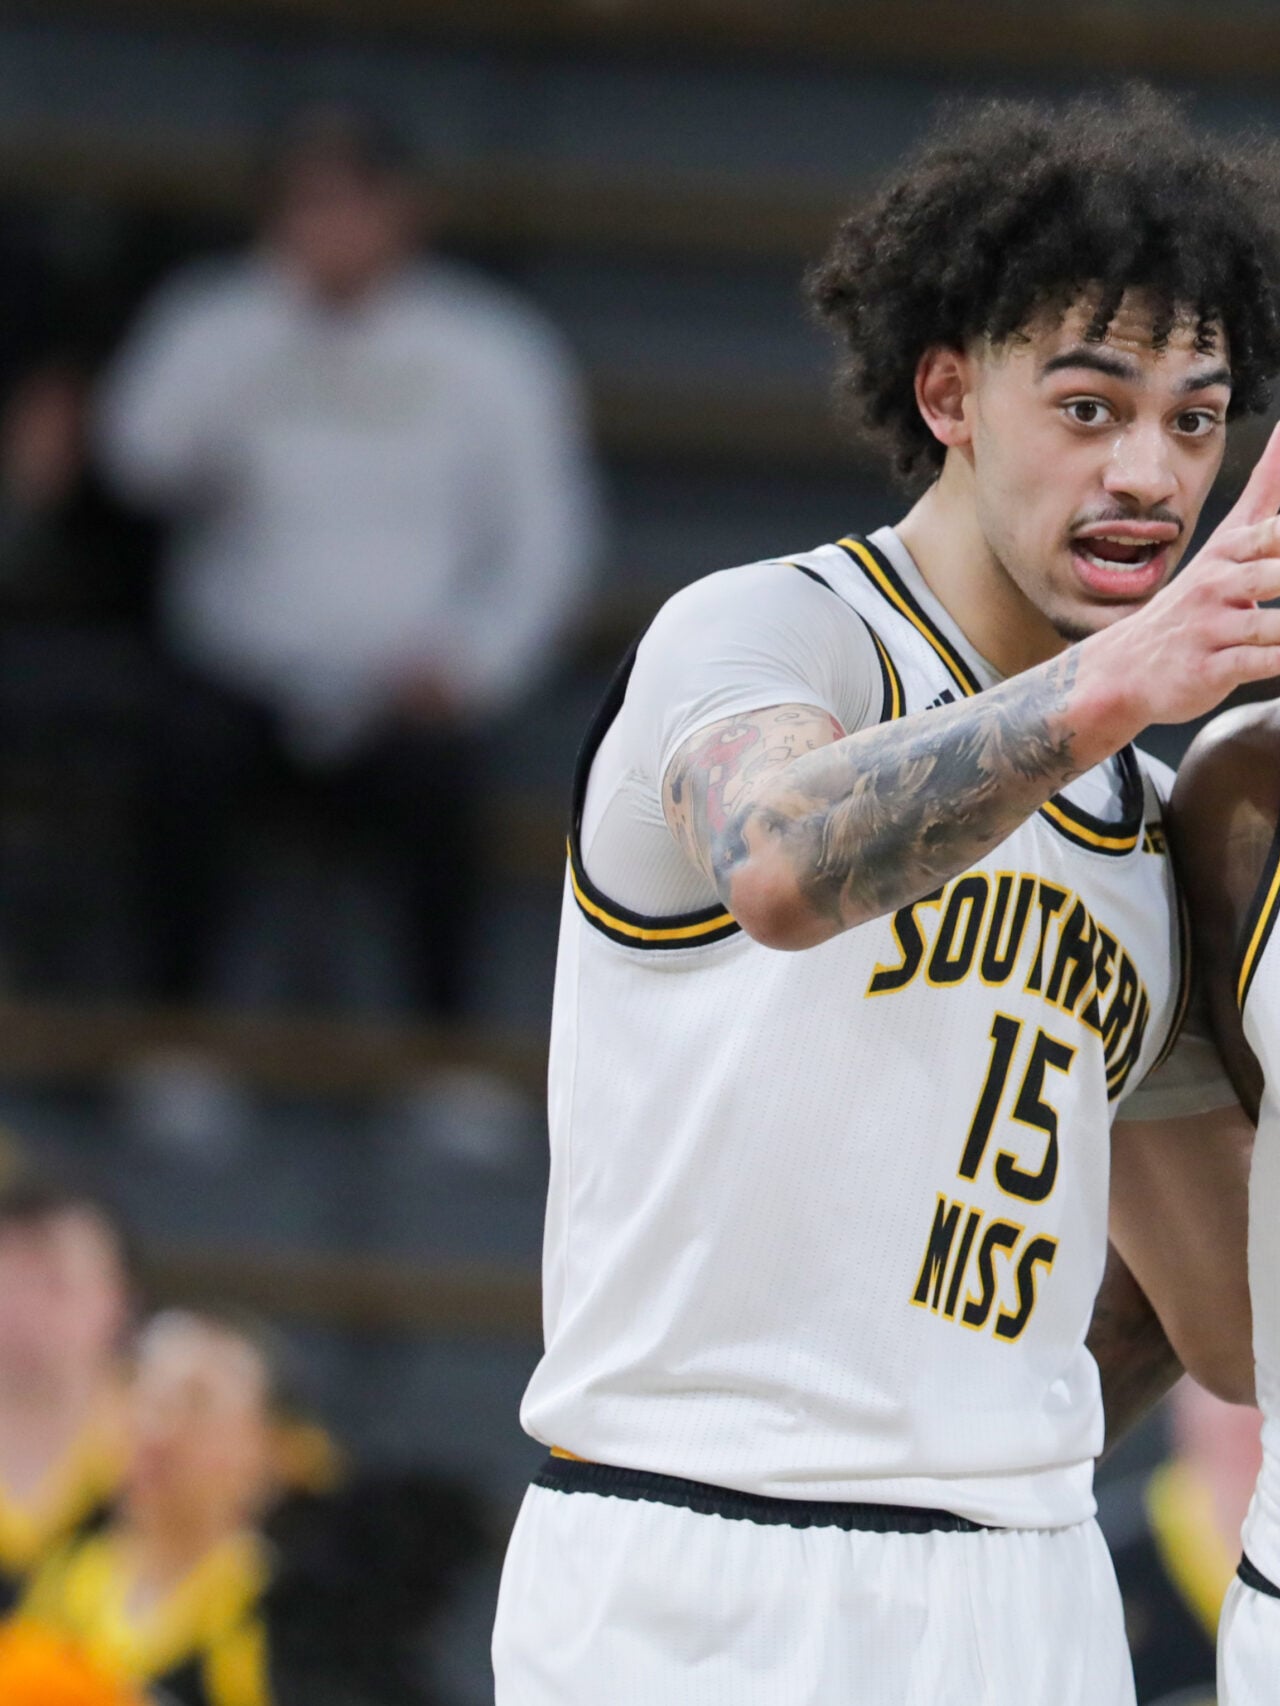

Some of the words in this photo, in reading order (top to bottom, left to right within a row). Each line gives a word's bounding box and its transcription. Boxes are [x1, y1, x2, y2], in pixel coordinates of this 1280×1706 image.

[864, 870, 1151, 1104] SOUTHERN
[956, 1010, 1078, 1203] 15
[910, 1191, 1060, 1344] MISS
